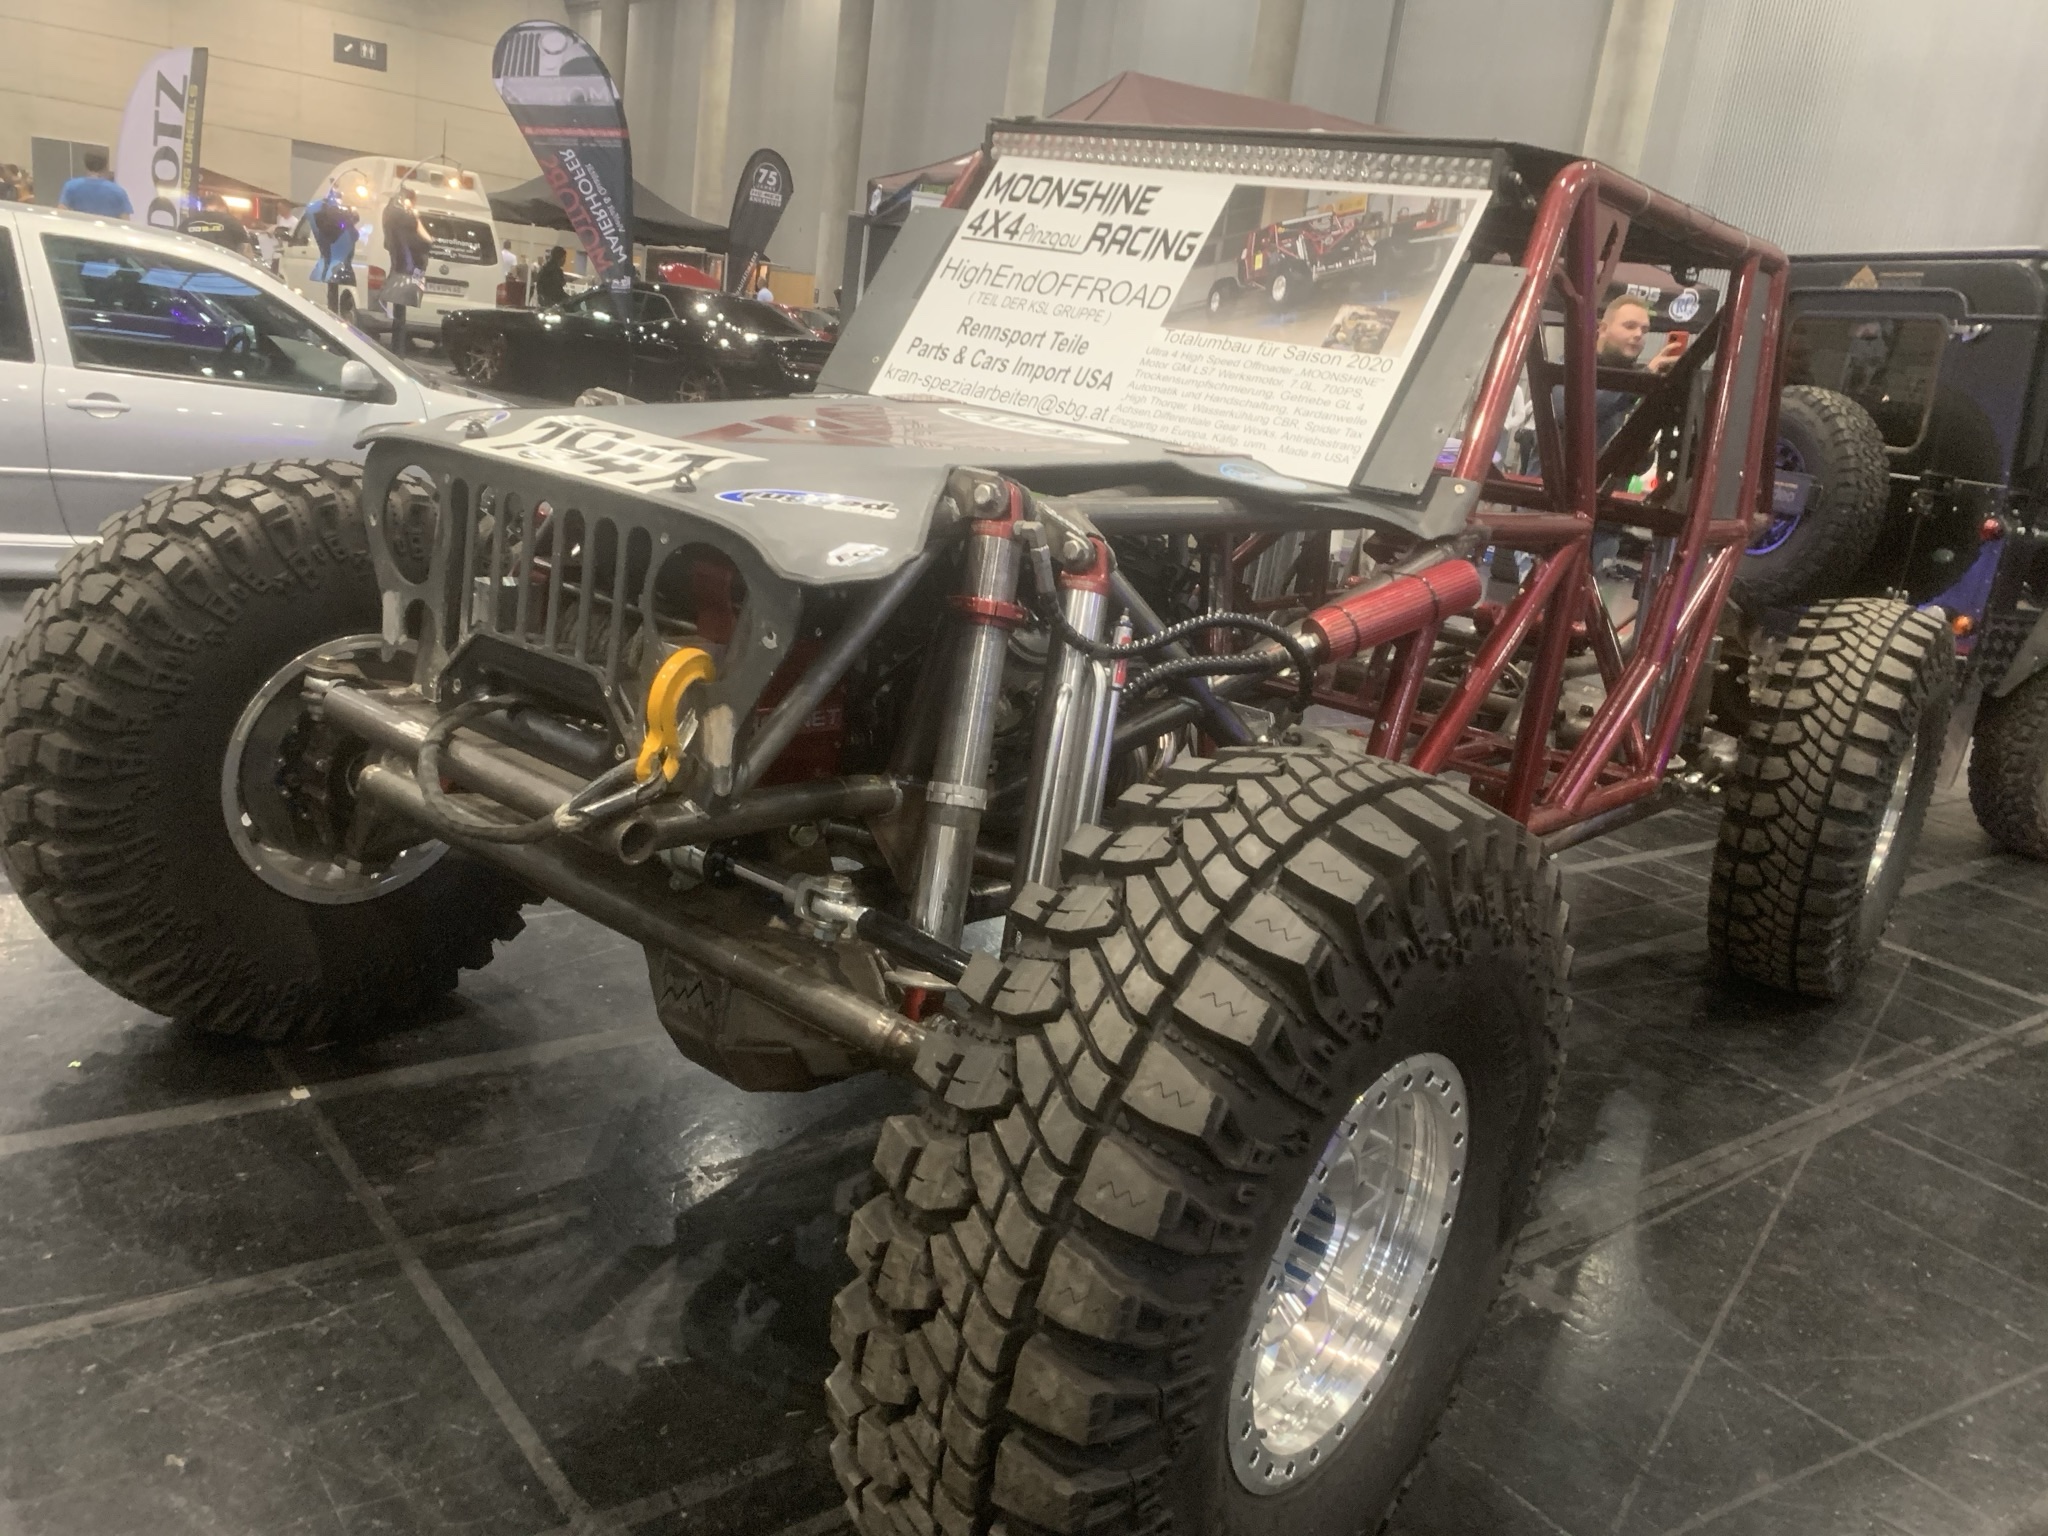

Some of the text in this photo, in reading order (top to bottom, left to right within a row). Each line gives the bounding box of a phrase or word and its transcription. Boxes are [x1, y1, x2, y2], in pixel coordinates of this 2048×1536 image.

[147, 70, 188, 230] DOTZ
[758, 168, 777, 187] 75
[984, 171, 1163, 216] MOONSHINE
[966, 208, 1027, 241] 4X4
[1085, 221, 1203, 262] RACING
[939, 257, 1172, 311] HighEndOFFROAD
[975, 292, 1003, 307] TEIL
[1001, 296, 1026, 310] DER
[1027, 300, 1050, 315] KSL
[1053, 304, 1104, 323] GRUPPE
[956, 316, 1089, 355] Rennsport Teile
[1145, 346, 1169, 358] Ultra
[1171, 349, 1178, 359] 4
[1180, 351, 1204, 363] High
[1206, 354, 1241, 368] Speed
[1163, 329, 1394, 374] Totalumbau für Saison 2020
[906, 337, 1115, 391] Parts & Cars Import USA
[1139, 357, 1169, 370] Motor
[1171, 361, 1191, 373] GM
[1193, 364, 1216, 377] LS7
[884, 363, 1110, 422] kran-spezialarbeiten@sbg.at
[1127, 380, 1178, 396] Automatik
[1180, 389, 1202, 400] und
[1293, 406, 1368, 426] Kardanwelle
[1280, 390, 1331, 407] Getriebe
[1335, 398, 1352, 410] GL
[1356, 402, 1365, 412] 4
[1108, 414, 1158, 432] Einzigartig
[1160, 421, 1169, 433] in
[1278, 444, 1309, 459] Made
[1311, 450, 1321, 460] in
[1192, 404, 1271, 425] Wasserkühlung
[1304, 420, 1341, 436] Spider
[1344, 426, 1363, 439] Tax
[1213, 419, 1240, 432] Gear
[1280, 430, 1362, 455] Antriebsstrang
